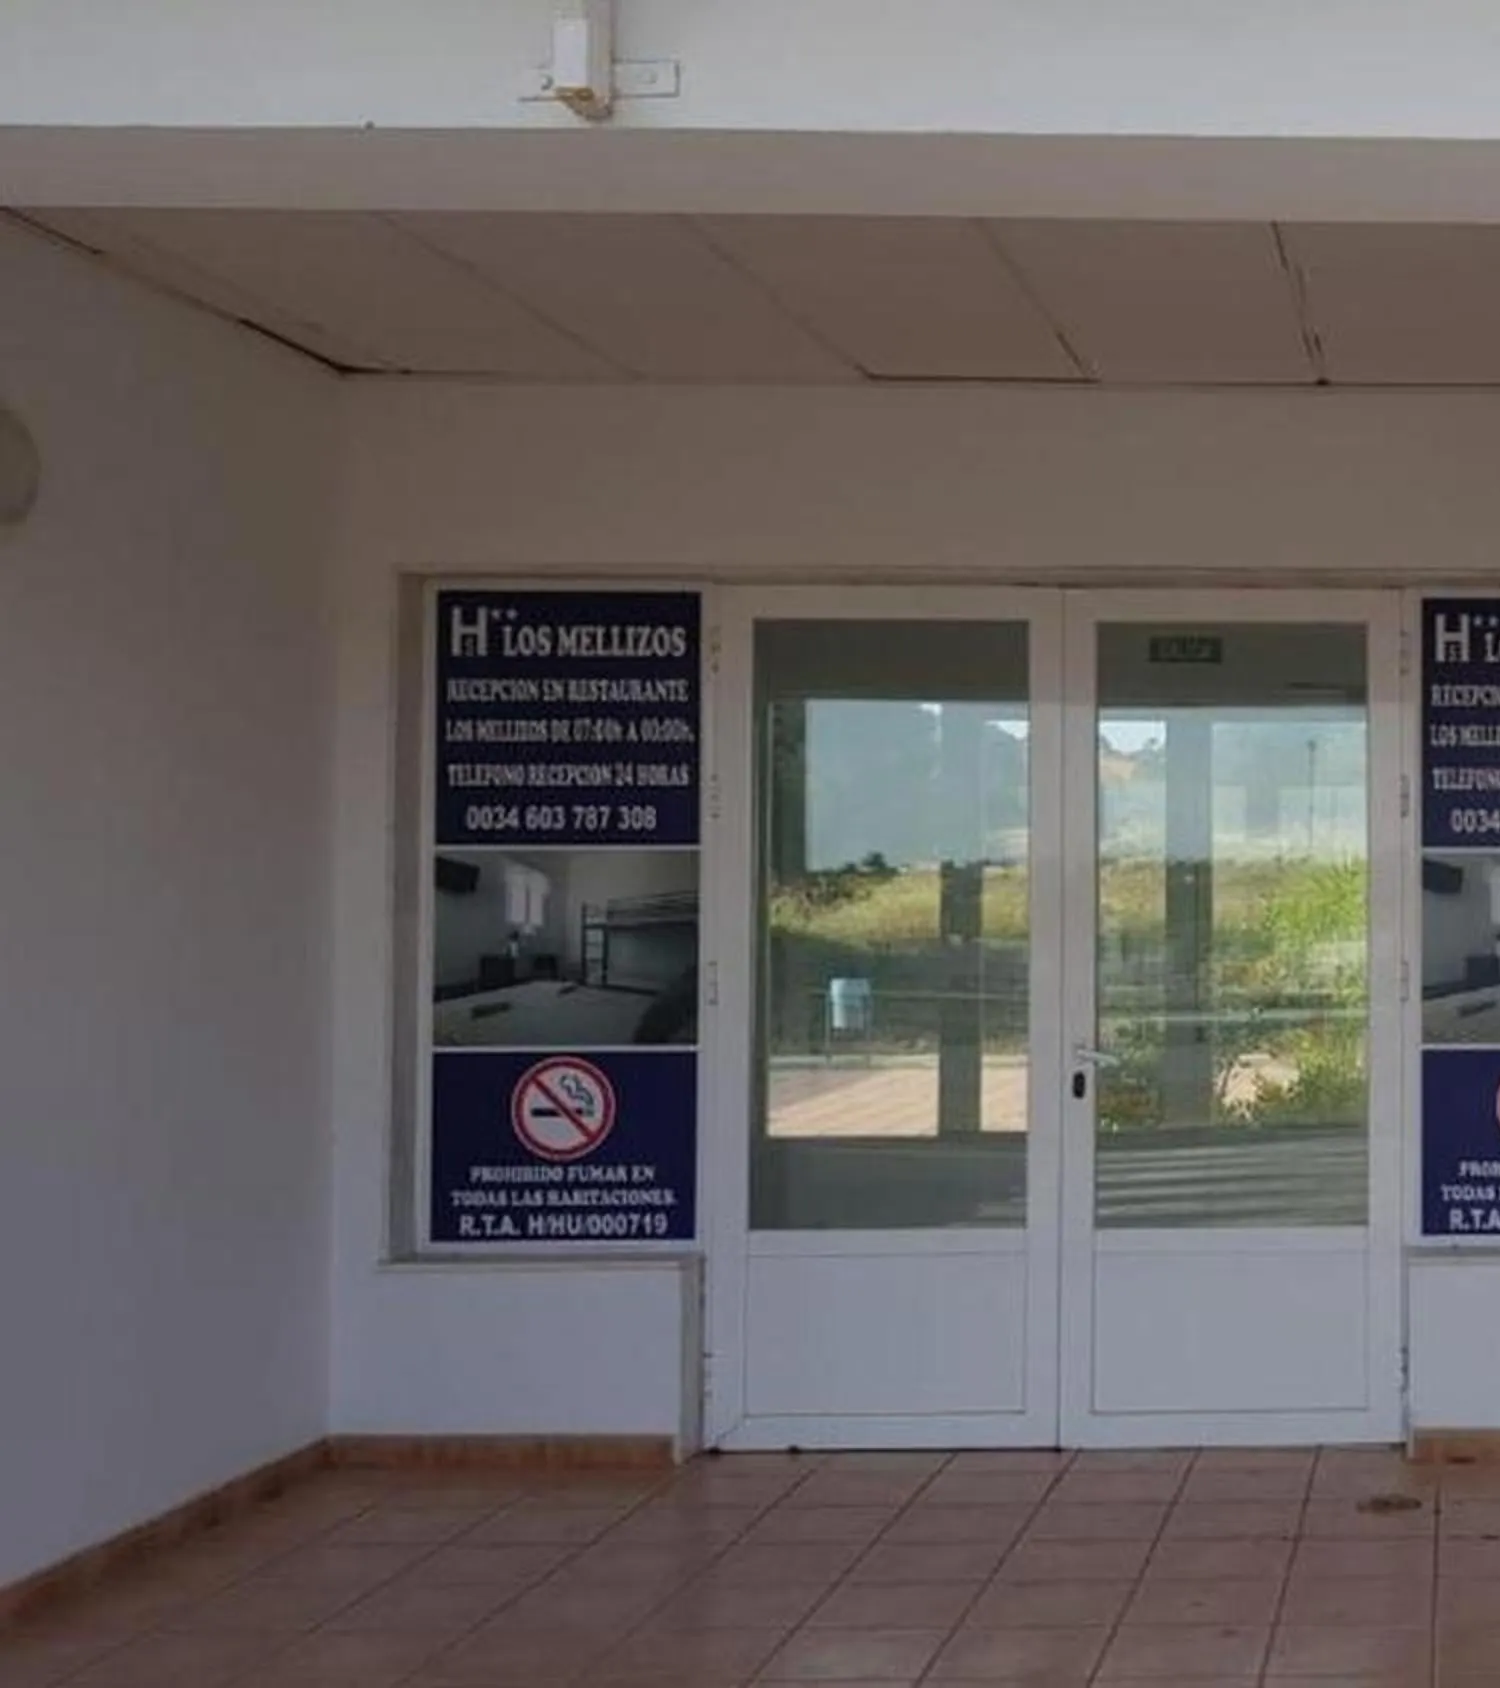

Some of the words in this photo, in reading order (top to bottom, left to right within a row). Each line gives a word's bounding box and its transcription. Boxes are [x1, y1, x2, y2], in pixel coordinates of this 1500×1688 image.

[503, 626, 550, 657] LOS
[557, 626, 687, 657] MELLIZOS
[446, 678, 540, 703] RECEPCION
[543, 678, 565, 703] EN
[568, 678, 689, 703] RESTAURANTE
[445, 718, 473, 742] LOS
[476, 718, 547, 742] MELLIZOS
[550, 718, 571, 742] DE
[626, 718, 638, 742] A
[1430, 722, 1457, 747] LOS
[448, 763, 525, 787] TELEFONO
[527, 763, 613, 787] RECEPCION
[615, 763, 633, 787] 24
[636, 763, 690, 787] HORAS
[466, 804, 519, 831] 0034
[525, 804, 566, 831] 603
[571, 804, 611, 831] 787
[617, 804, 658, 831] 308
[1450, 808, 1500, 833] 0034
[469, 1165, 564, 1183] PROHIBIDO
[567, 1165, 628, 1183] FUMAR
[631, 1165, 656, 1183] EN
[450, 1189, 507, 1207] TODAS
[511, 1189, 544, 1207] LAS
[1441, 1184, 1496, 1201] TODAS
[458, 1214, 522, 1236] R.T.A.
[527, 1214, 669, 1236] H/HU/000719
